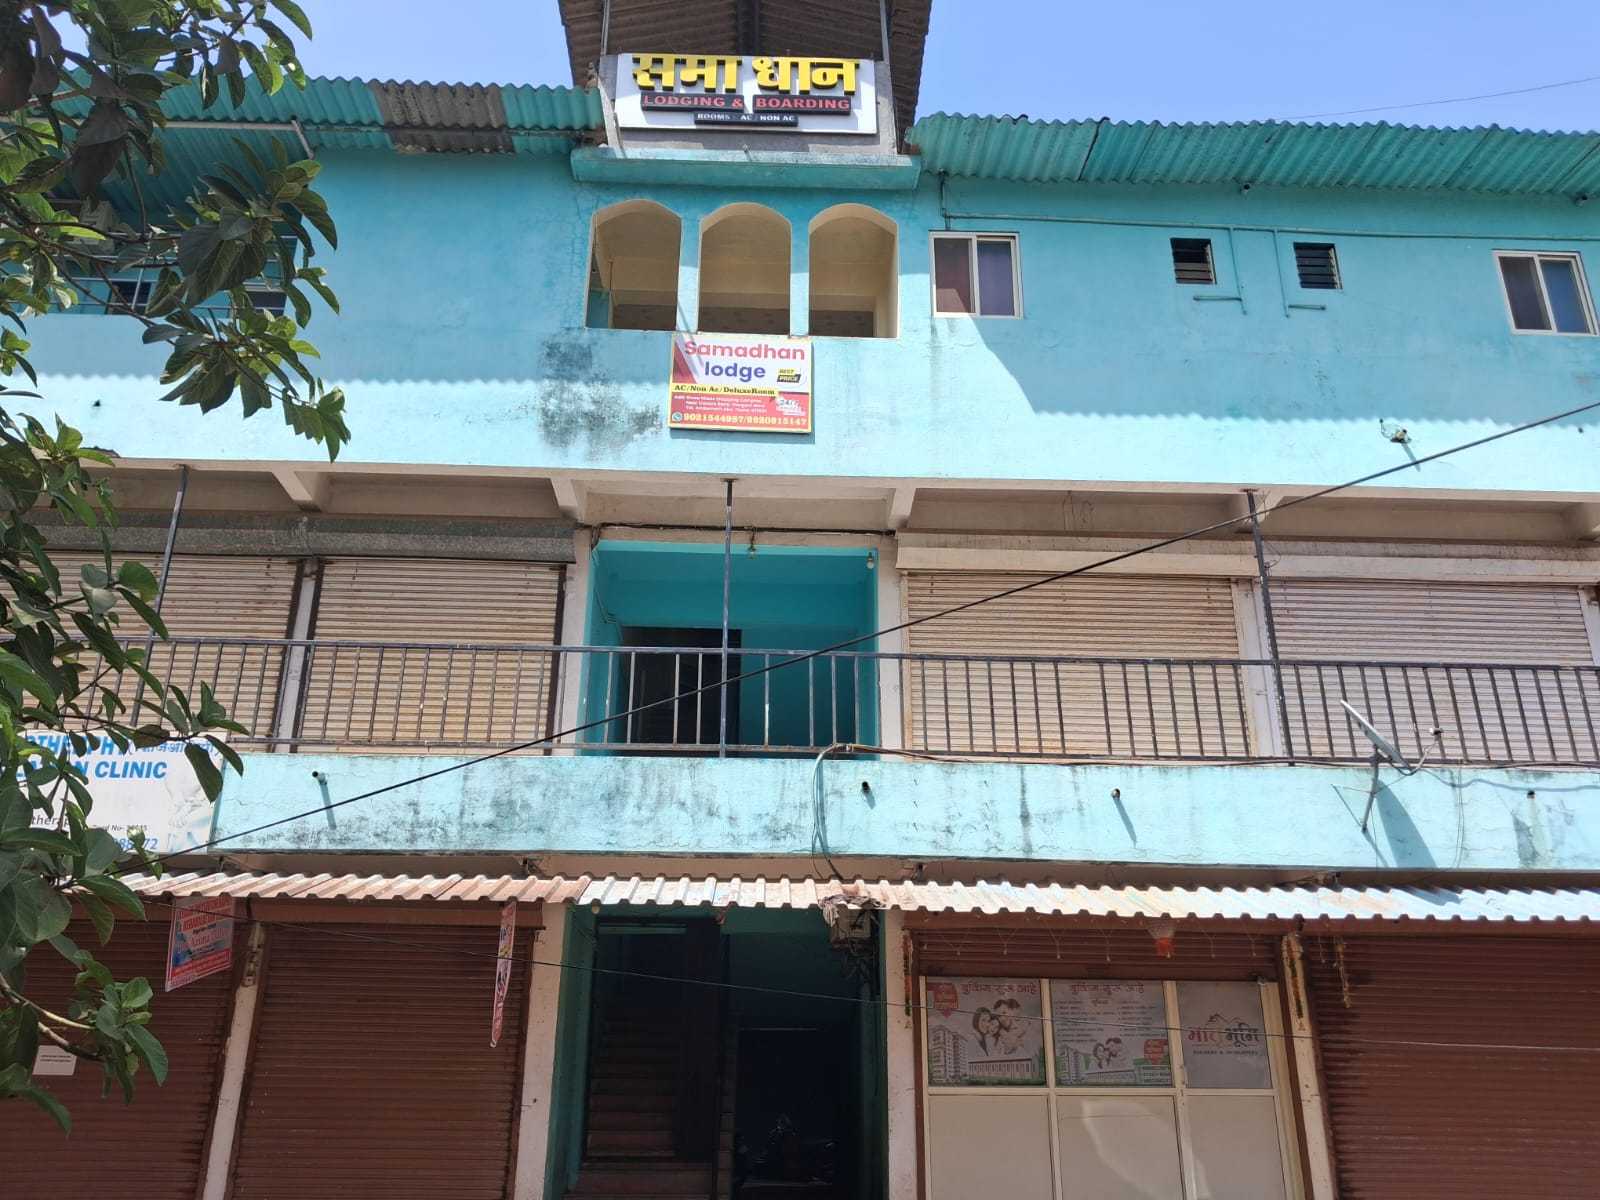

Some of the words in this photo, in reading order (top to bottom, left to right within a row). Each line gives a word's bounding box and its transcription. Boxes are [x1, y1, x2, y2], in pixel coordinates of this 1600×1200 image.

[643, 95, 726, 108] LODGING
[732, 97, 744, 108] &
[755, 97, 850, 110] BOARDING
[760, 114, 780, 122] NON
[782, 114, 795, 122] AC
[685, 340, 806, 361] Samadhan
[705, 361, 767, 383] lodge
[94, 761, 168, 779] CLINIC
